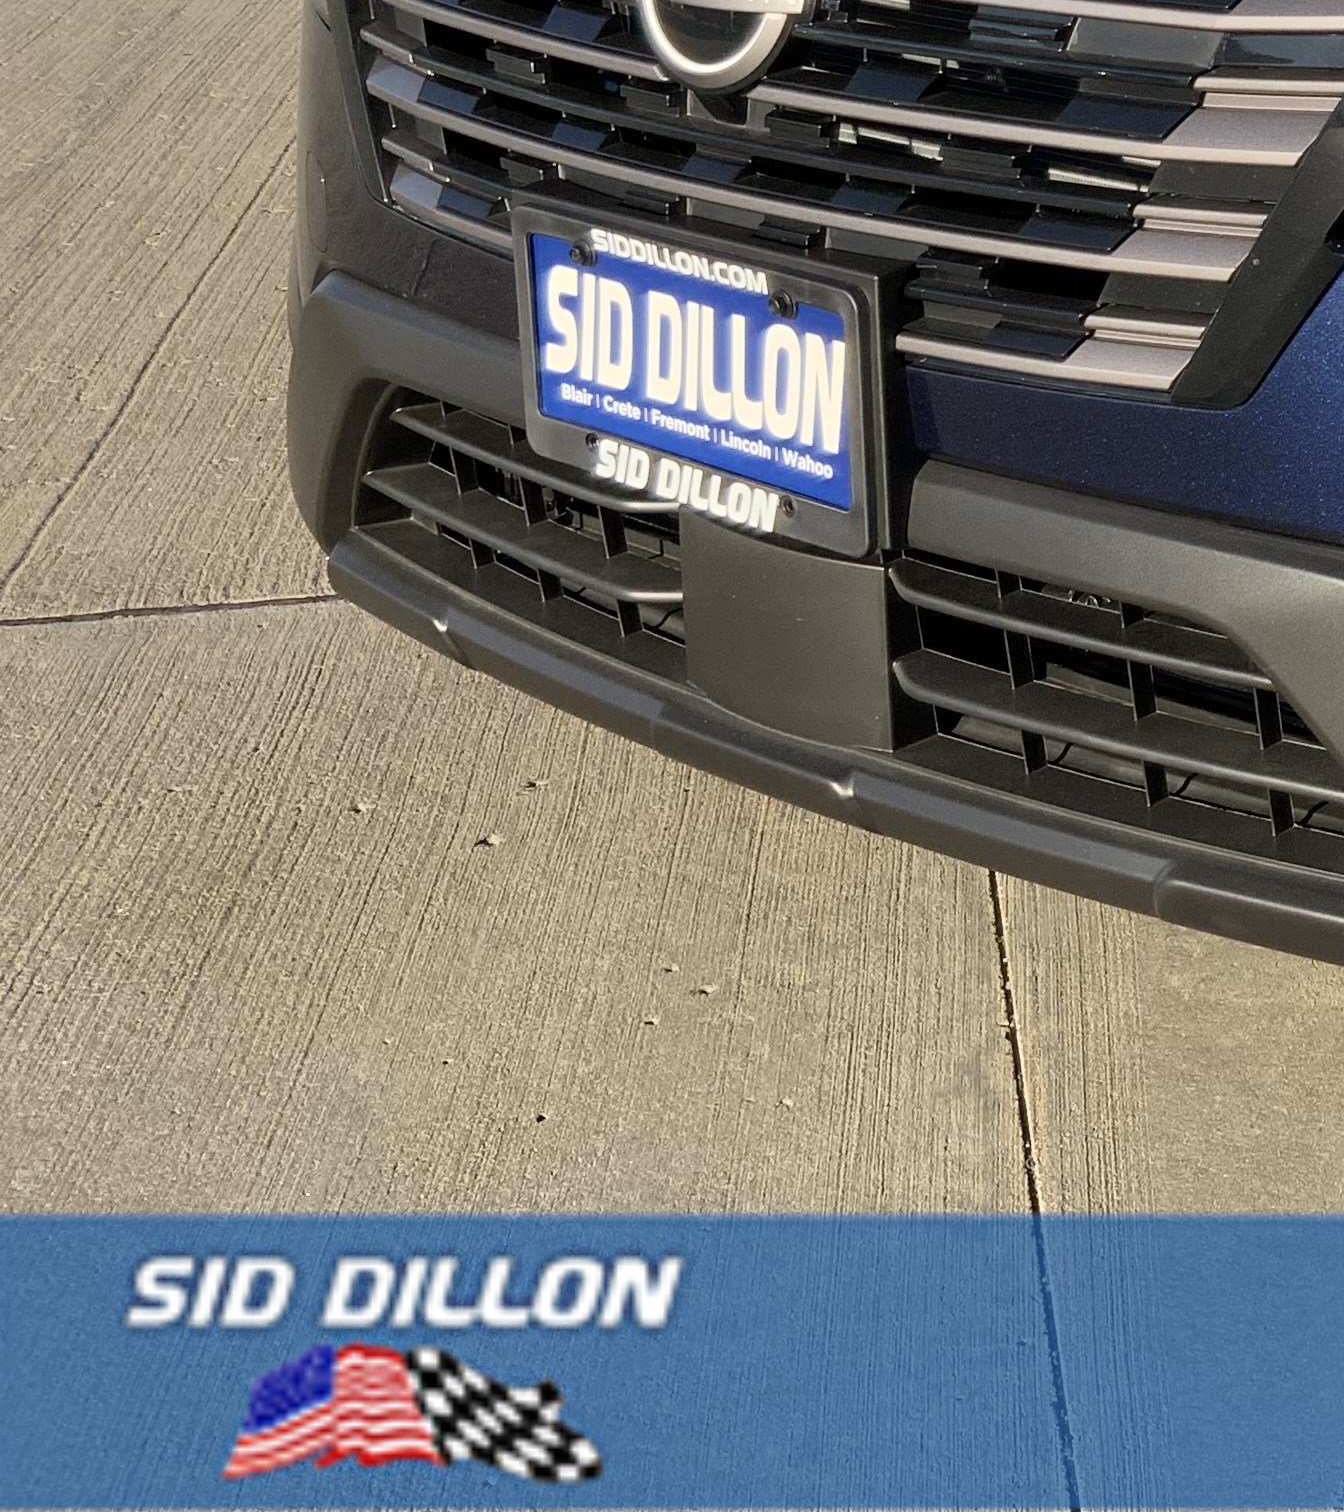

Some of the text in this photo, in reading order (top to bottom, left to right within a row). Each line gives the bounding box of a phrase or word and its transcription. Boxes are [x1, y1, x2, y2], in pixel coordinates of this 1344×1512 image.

[590, 228, 769, 296] SIDDILLON.COM
[545, 264, 846, 455] SID DILLON
[561, 383, 834, 481] Blair Crete Fremont Lincoln Wahoo
[594, 438, 781, 534] SID DILLON
